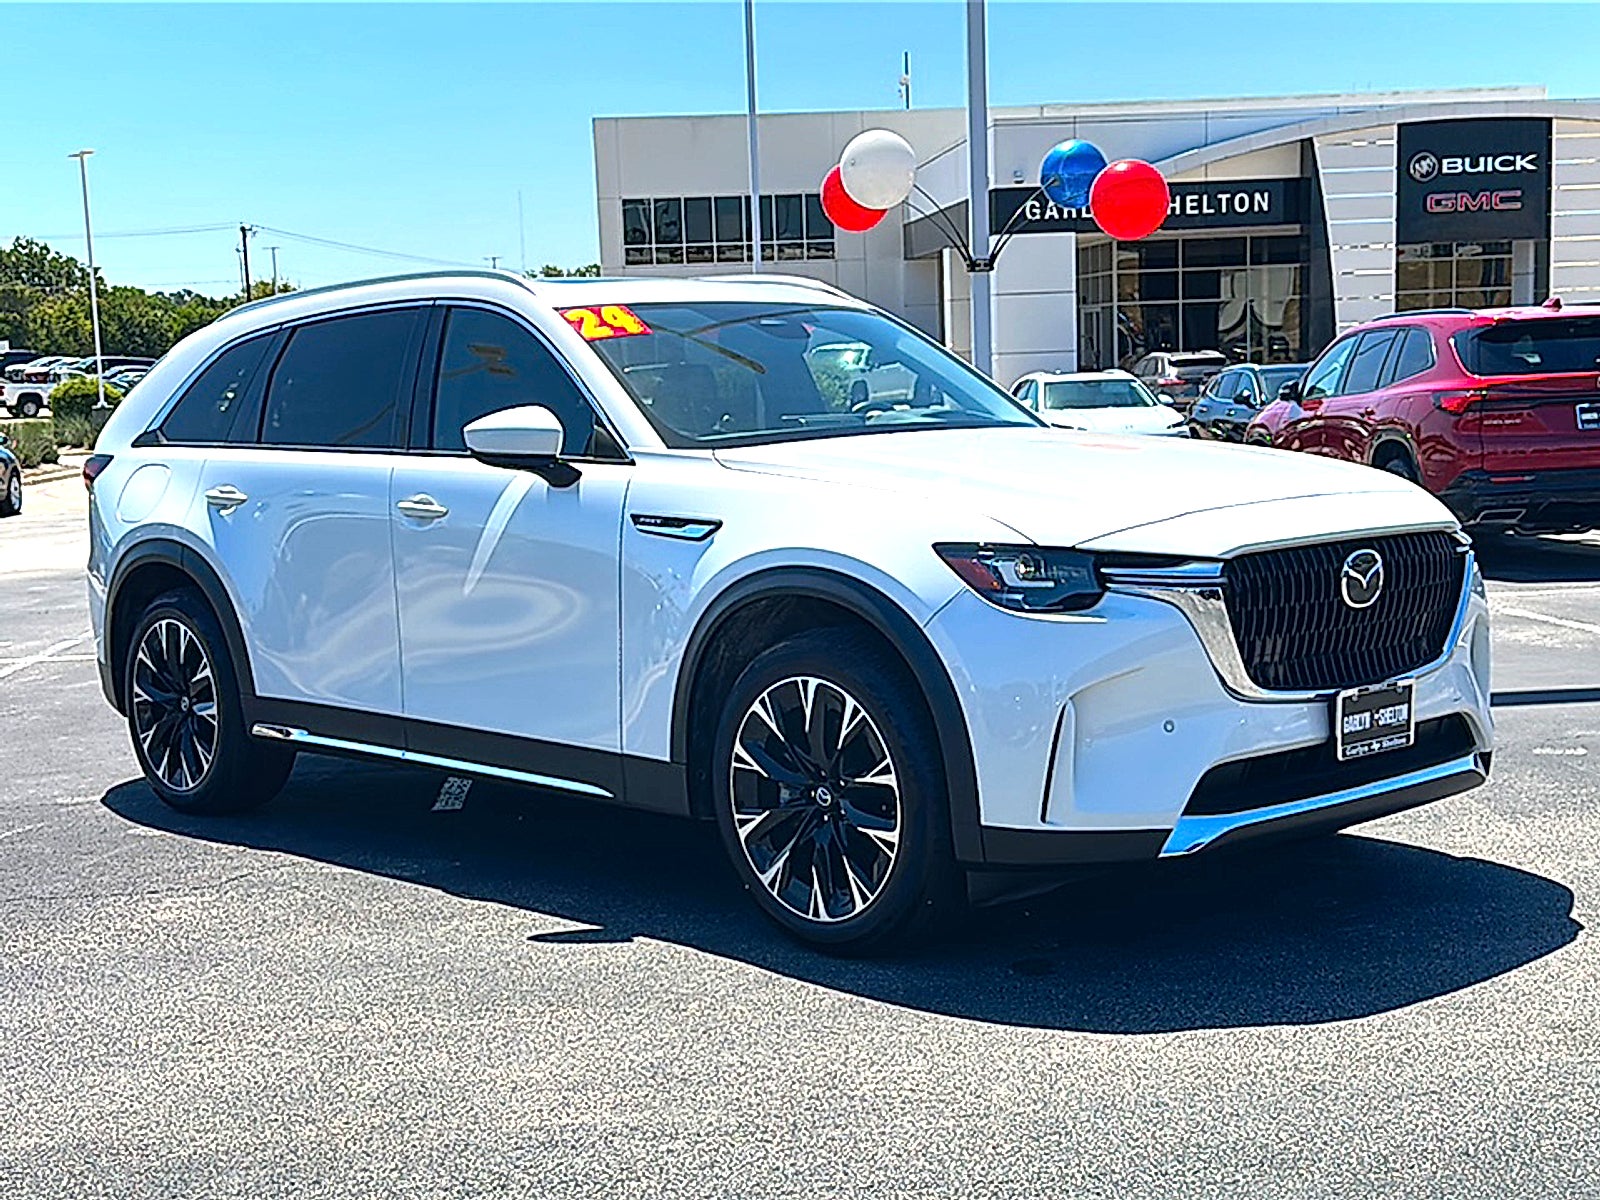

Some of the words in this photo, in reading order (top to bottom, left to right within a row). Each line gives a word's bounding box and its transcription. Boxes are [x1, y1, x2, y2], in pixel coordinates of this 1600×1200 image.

[1442, 154, 1538, 174] BUICK
[1026, 200, 1093, 220] GARL
[1167, 192, 1269, 215] HELTON
[1427, 190, 1522, 212] GMC
